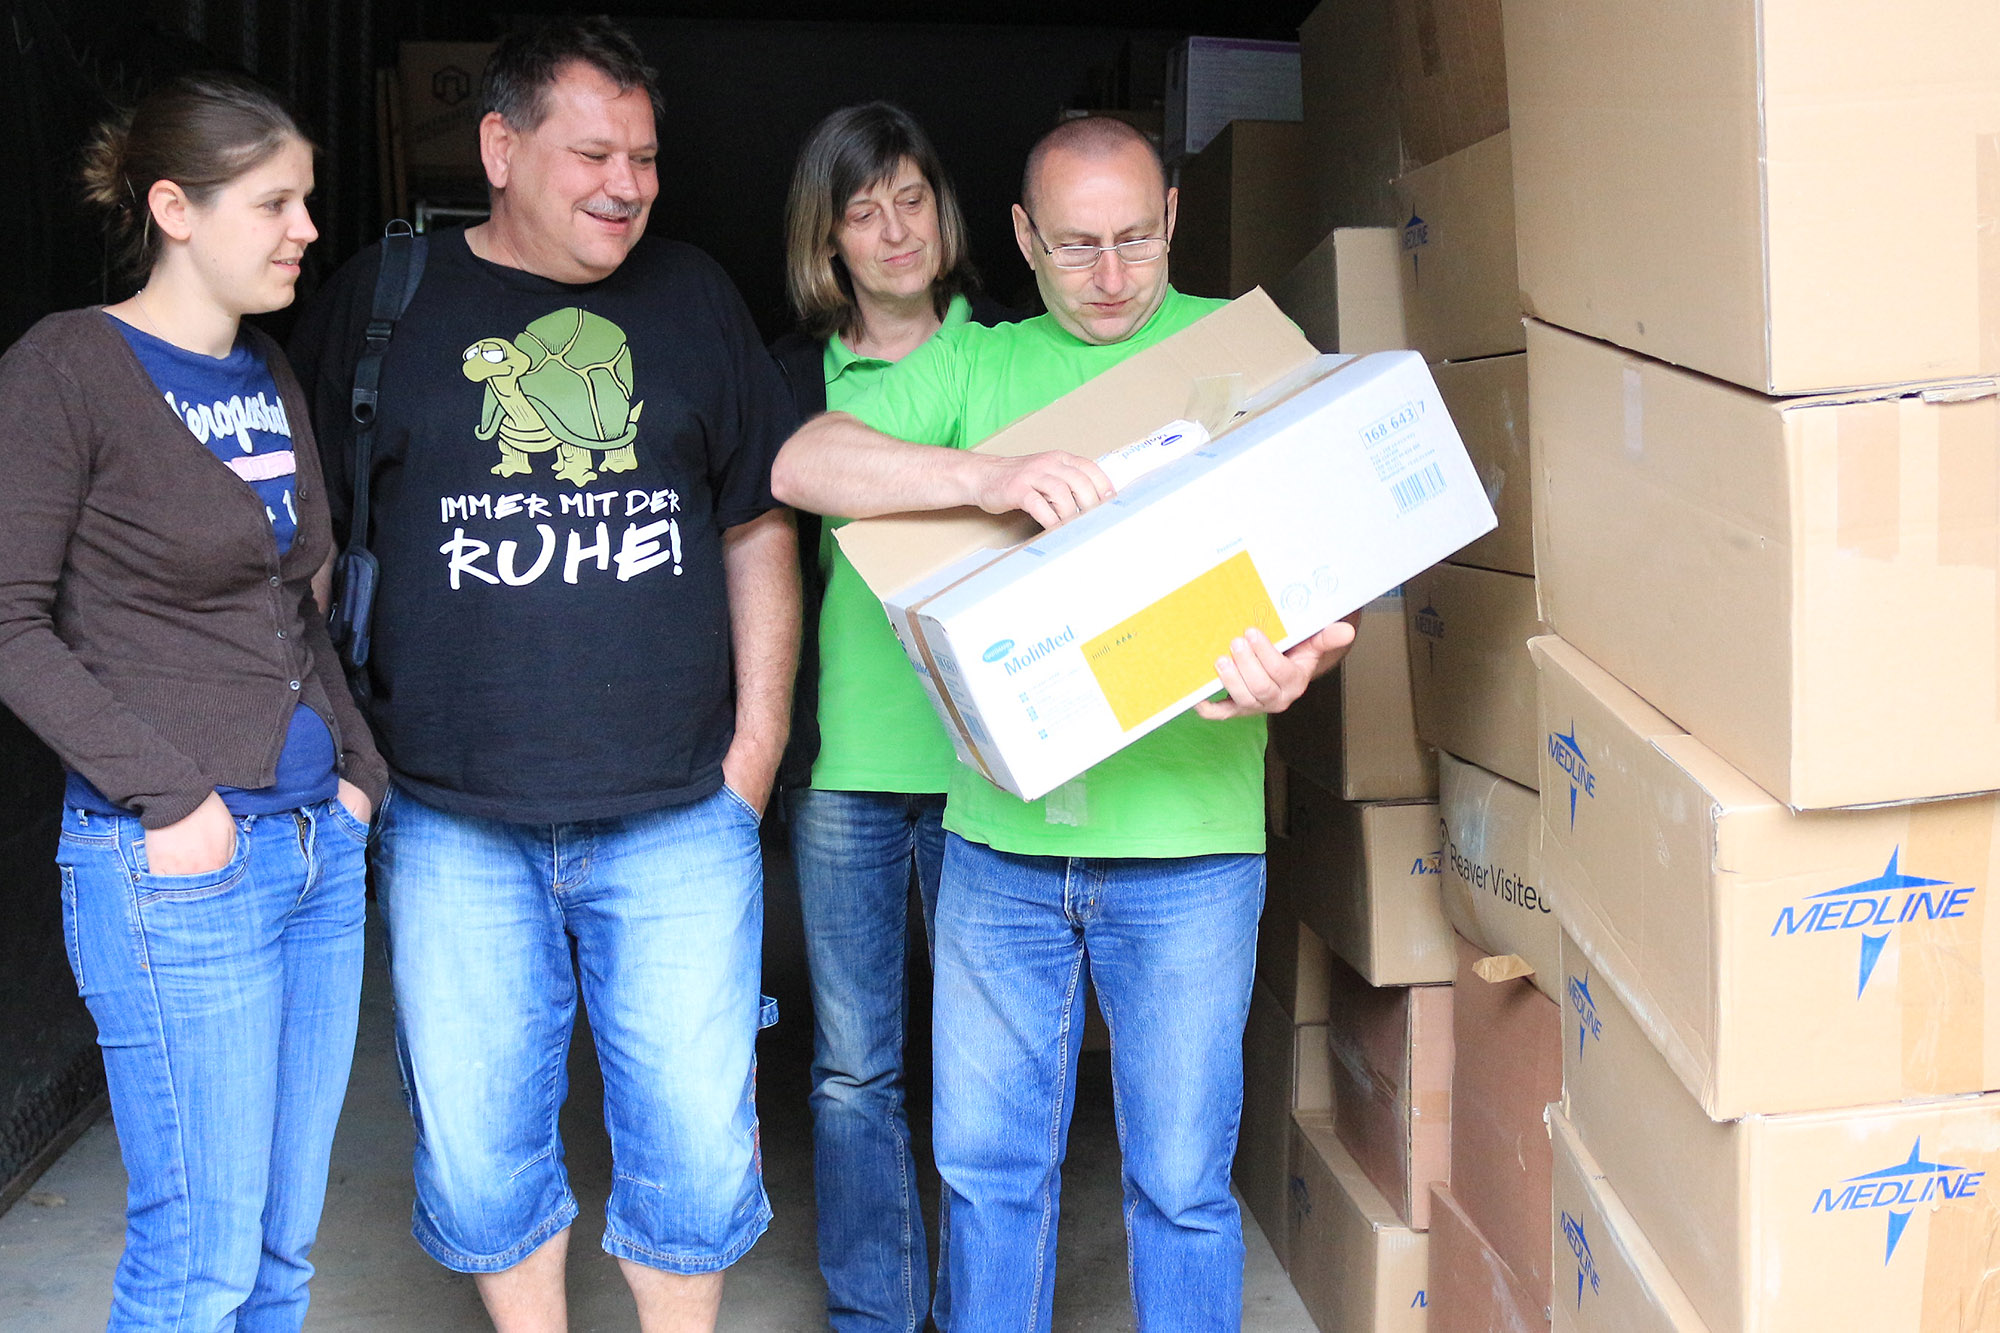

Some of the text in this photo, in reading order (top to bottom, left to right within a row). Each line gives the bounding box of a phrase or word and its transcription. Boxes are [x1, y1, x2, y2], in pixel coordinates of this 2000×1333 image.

[1364, 423, 1388, 444] 168
[1390, 407, 1415, 430] 643
[440, 488, 681, 523] IMMER MIT DER
[439, 517, 683, 590] RUHE!
[1004, 624, 1075, 677] MoliMed
[1548, 733, 1596, 799] MEDLINE
[1770, 887, 1976, 937] MEDLINE
[1568, 975, 1602, 1042] MEDLINE
[1811, 1171, 1986, 1214] MEDLINE
[1560, 1210, 1600, 1296] MEDLINE
